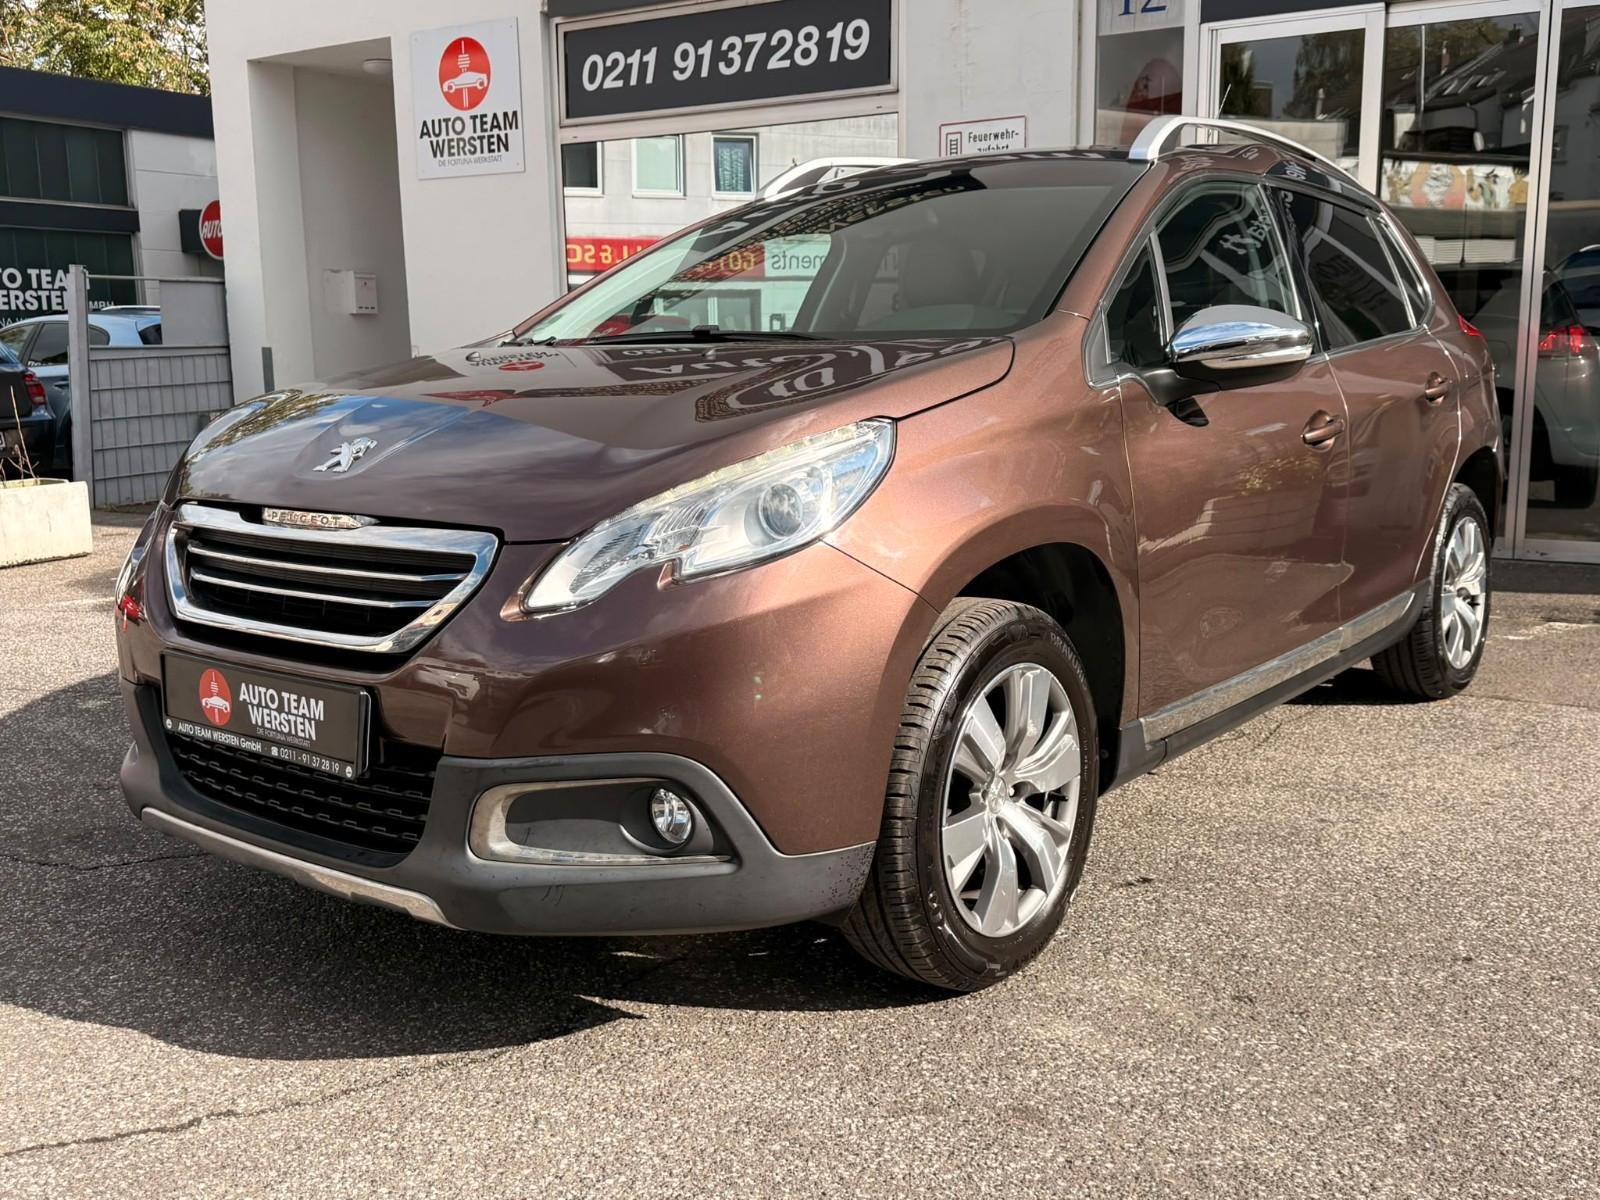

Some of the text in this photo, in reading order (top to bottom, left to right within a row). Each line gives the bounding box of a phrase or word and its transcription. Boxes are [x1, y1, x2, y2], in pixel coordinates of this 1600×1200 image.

[582, 46, 658, 92] 0211
[419, 110, 519, 139] AUTO TEAM
[967, 128, 1020, 144] Feuerwehr-
[429, 132, 510, 158] WERSTEN
[0, 289, 68, 311] ERSTE
[271, 511, 342, 526] PEUGEOT
[239, 682, 324, 721] AUTO TEAM
[248, 704, 316, 741] WERSTEN
[178, 722, 194, 735] AUTO
[194, 726, 212, 740] TEAM
[212, 730, 240, 746] WERSTEN
[240, 738, 262, 752] GmbH
[280, 748, 296, 761] 0211
[302, 753, 310, 765] 91
[312, 756, 320, 767] 37
[321, 759, 330, 770] 28
[332, 761, 340, 774] 19
